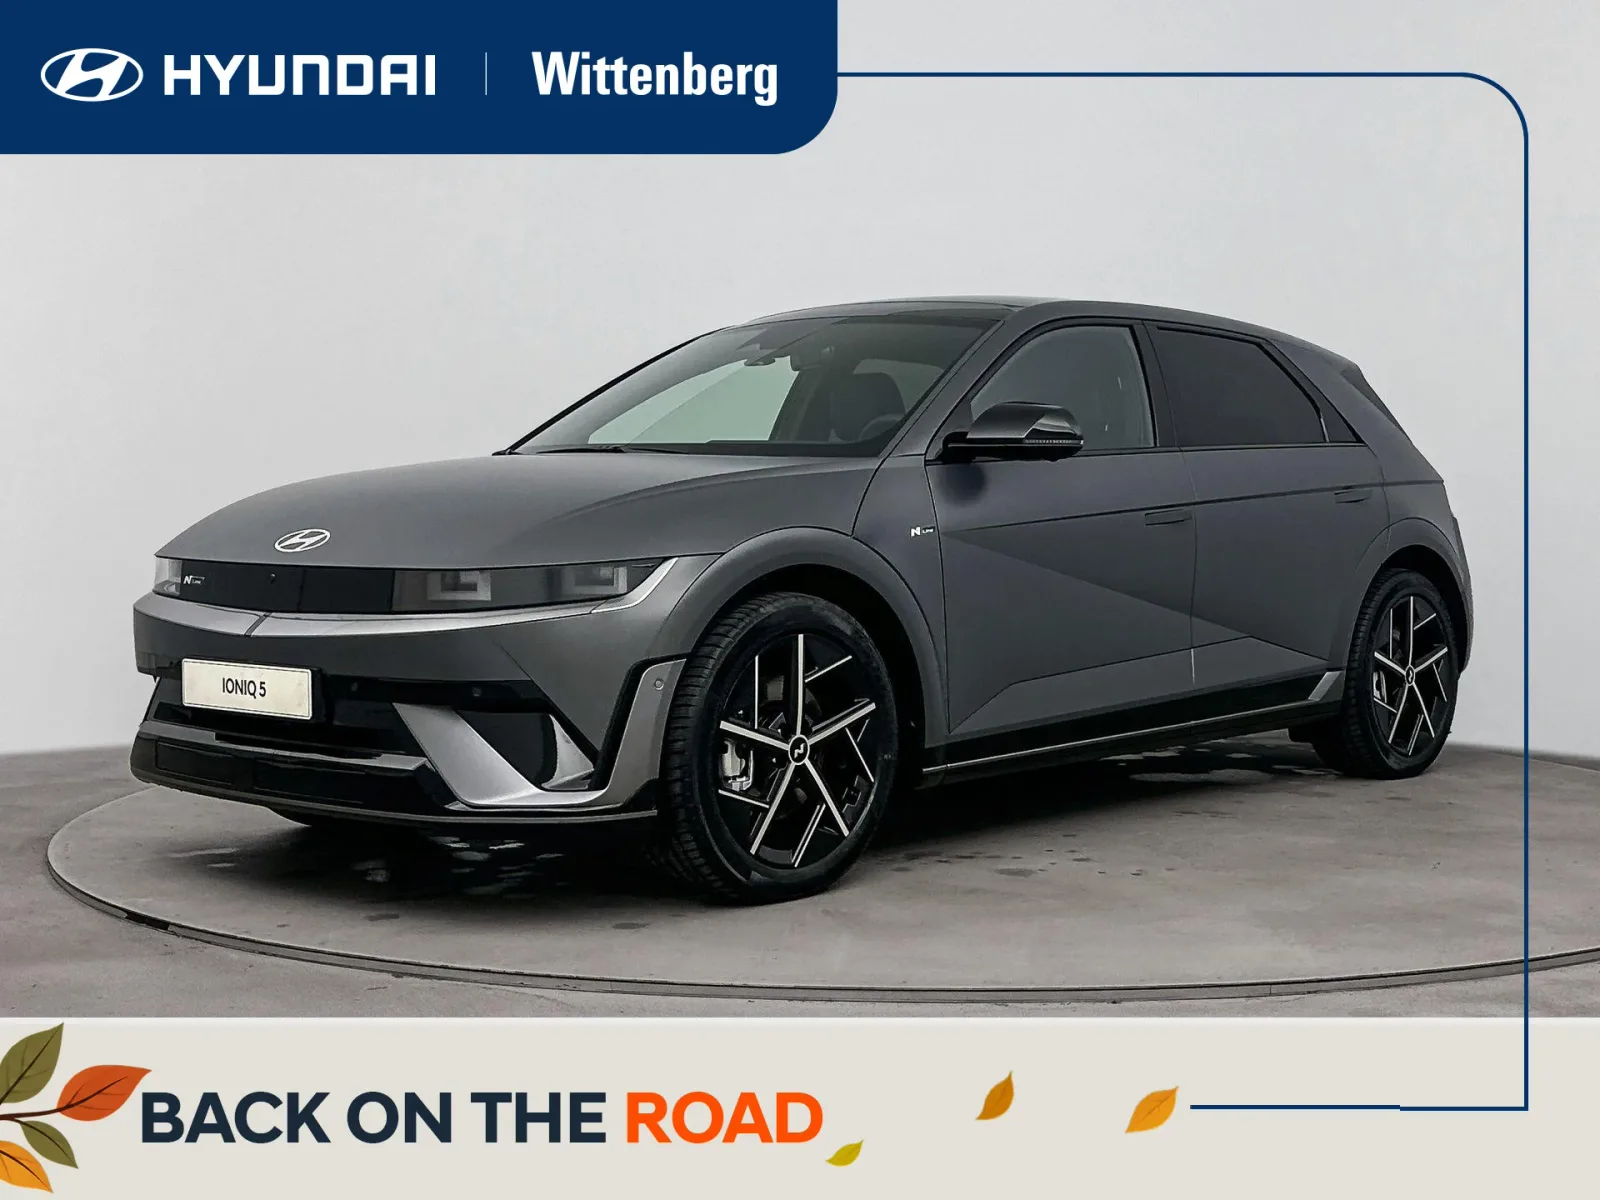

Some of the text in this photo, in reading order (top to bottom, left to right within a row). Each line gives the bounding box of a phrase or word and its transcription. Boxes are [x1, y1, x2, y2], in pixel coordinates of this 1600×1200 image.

[911, 526, 921, 537] N
[222, 677, 267, 700] IONIQ 5
